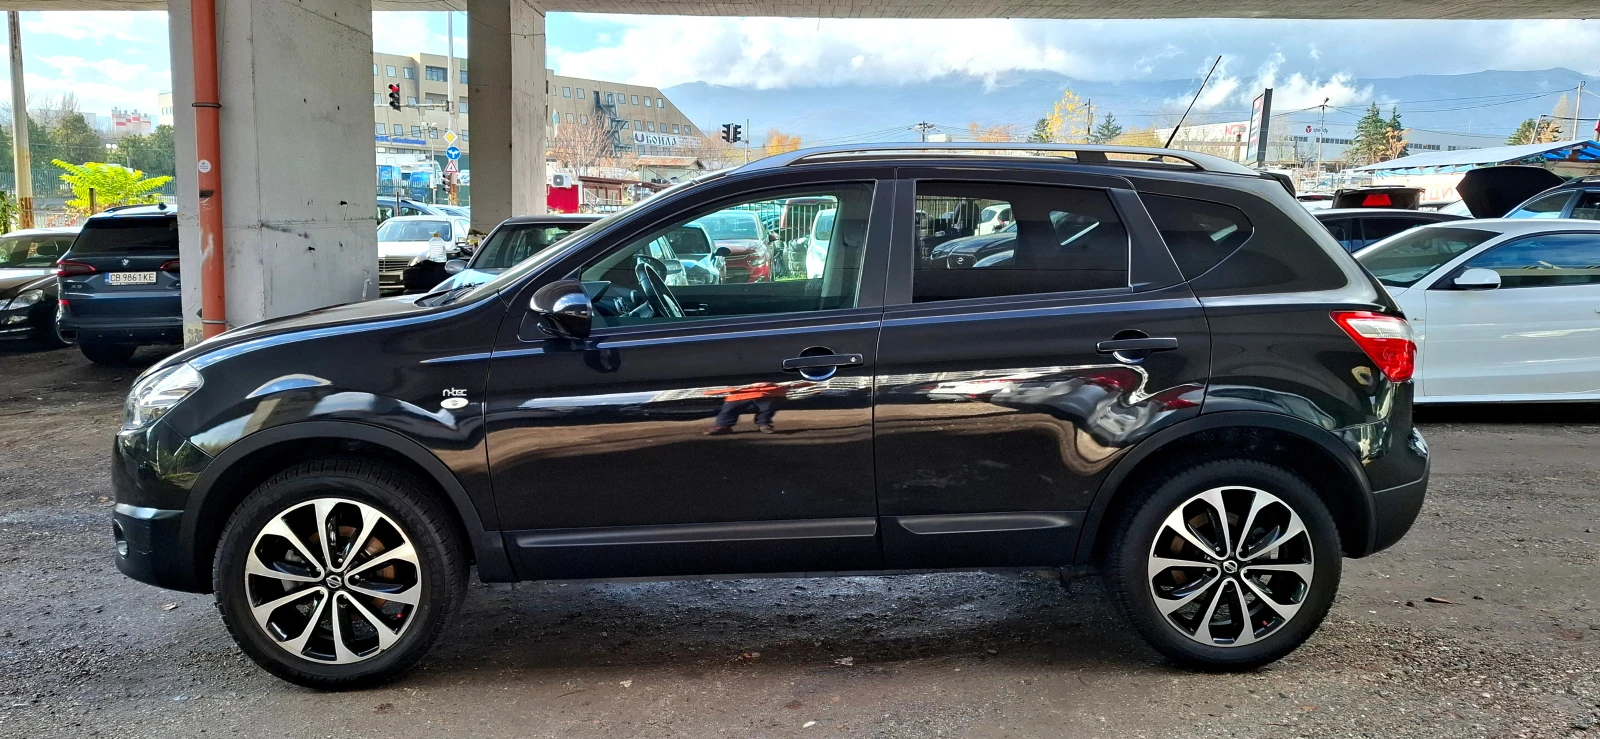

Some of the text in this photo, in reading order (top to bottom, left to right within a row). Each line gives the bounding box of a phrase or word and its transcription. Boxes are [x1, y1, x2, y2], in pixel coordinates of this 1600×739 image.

[110, 273, 154, 282] CB 9861 KE
[442, 387, 467, 396] n-tec
